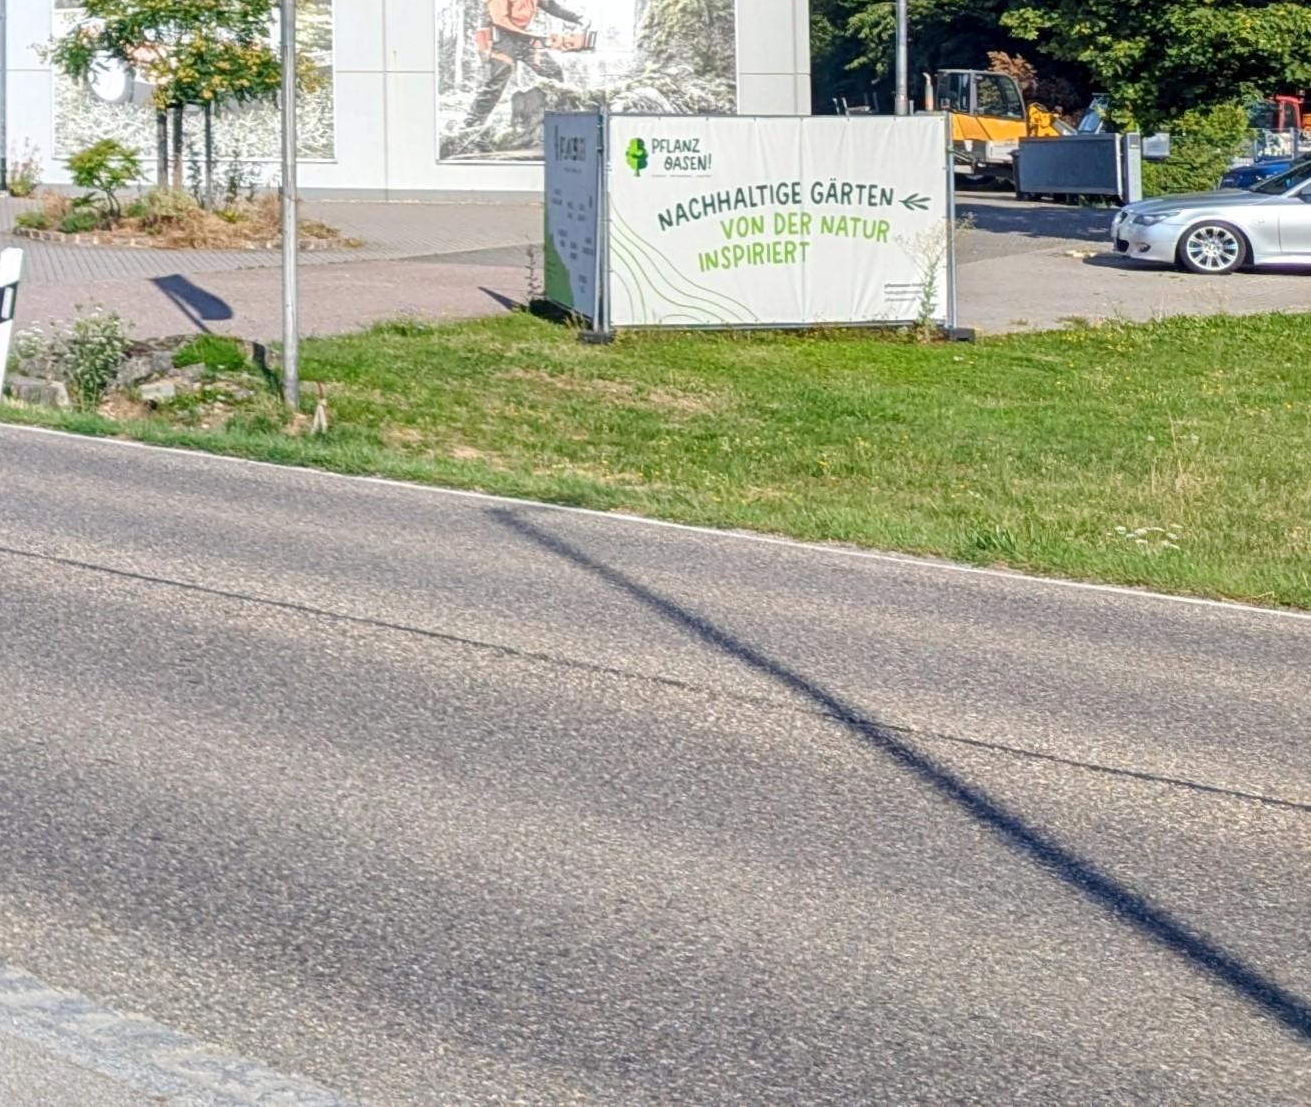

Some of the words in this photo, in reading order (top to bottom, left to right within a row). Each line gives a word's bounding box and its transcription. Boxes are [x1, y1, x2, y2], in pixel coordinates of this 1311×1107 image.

[652, 138, 700, 154] PFLANZ
[657, 181, 802, 231] NACHHALTIGE
[810, 178, 894, 206] GÄRTEN
[720, 215, 765, 239] VON
[774, 212, 812, 236] DER
[820, 215, 891, 243] NATUR
[698, 241, 810, 272] INSPIRIERT
